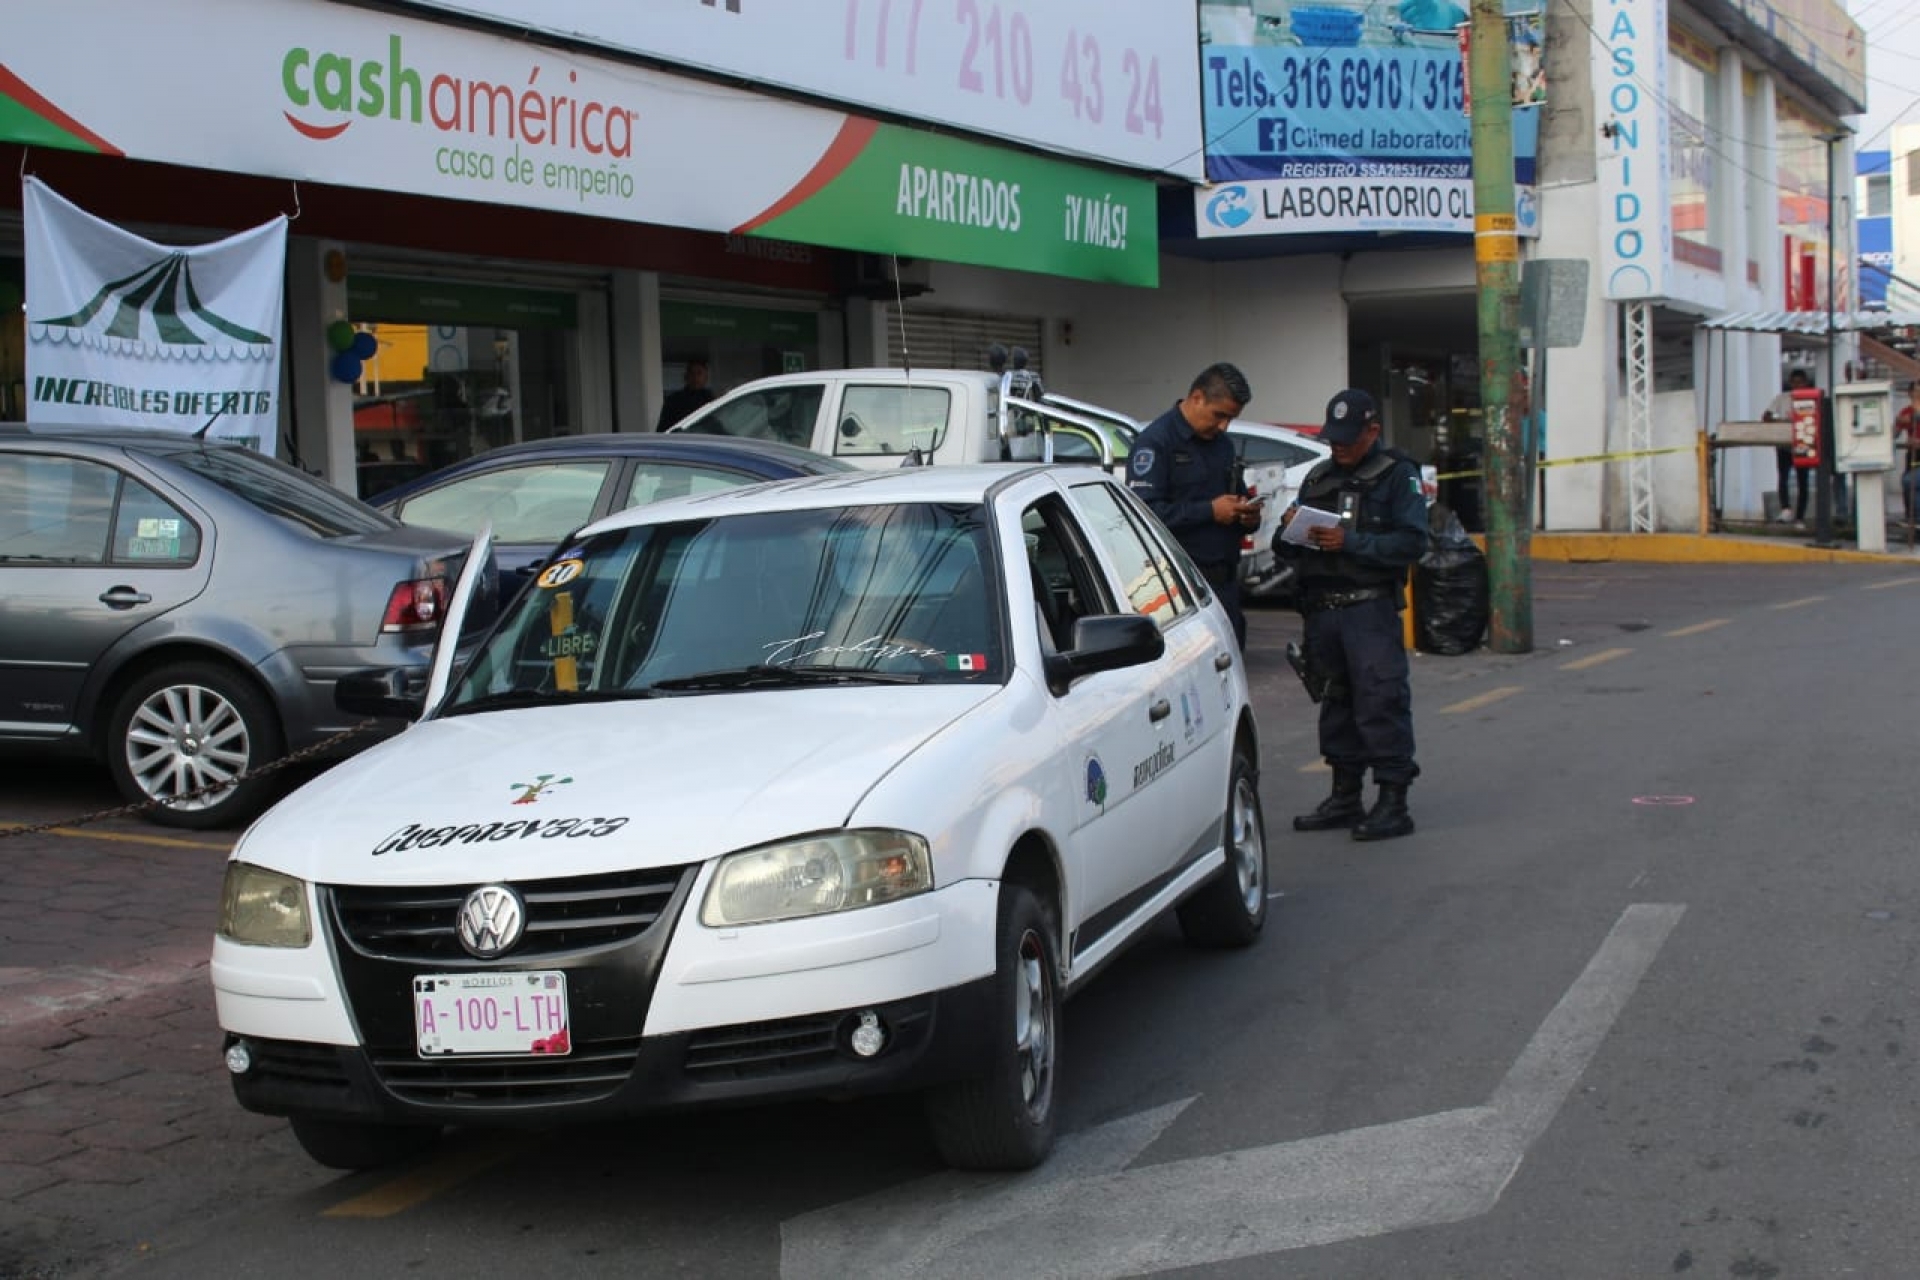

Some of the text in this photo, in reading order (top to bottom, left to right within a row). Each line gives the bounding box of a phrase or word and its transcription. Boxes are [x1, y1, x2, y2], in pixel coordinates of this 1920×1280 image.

[957, 0, 1033, 106] 210
[1060, 24, 1104, 125] 43
[1122, 47, 1164, 140] 24
[1208, 56, 1276, 108] Tels.
[1283, 56, 1332, 109] 316
[1341, 57, 1401, 109] 6910
[1608, 0, 1643, 259] ASONIDO
[436, 143, 634, 201] casa de empeño
[1281, 162, 1357, 178] REGISTRO
[897, 162, 1128, 251] APARTADOS ¡Y MÁS!
[1262, 184, 1443, 219] LABORATORIO
[33, 376, 169, 415] INCREIBLES
[549, 632, 593, 657] LIBRE
[372, 817, 630, 856] Cuernavaca
[462, 976, 514, 988] MORELOS
[422, 995, 562, 1034] A-100-LTH
